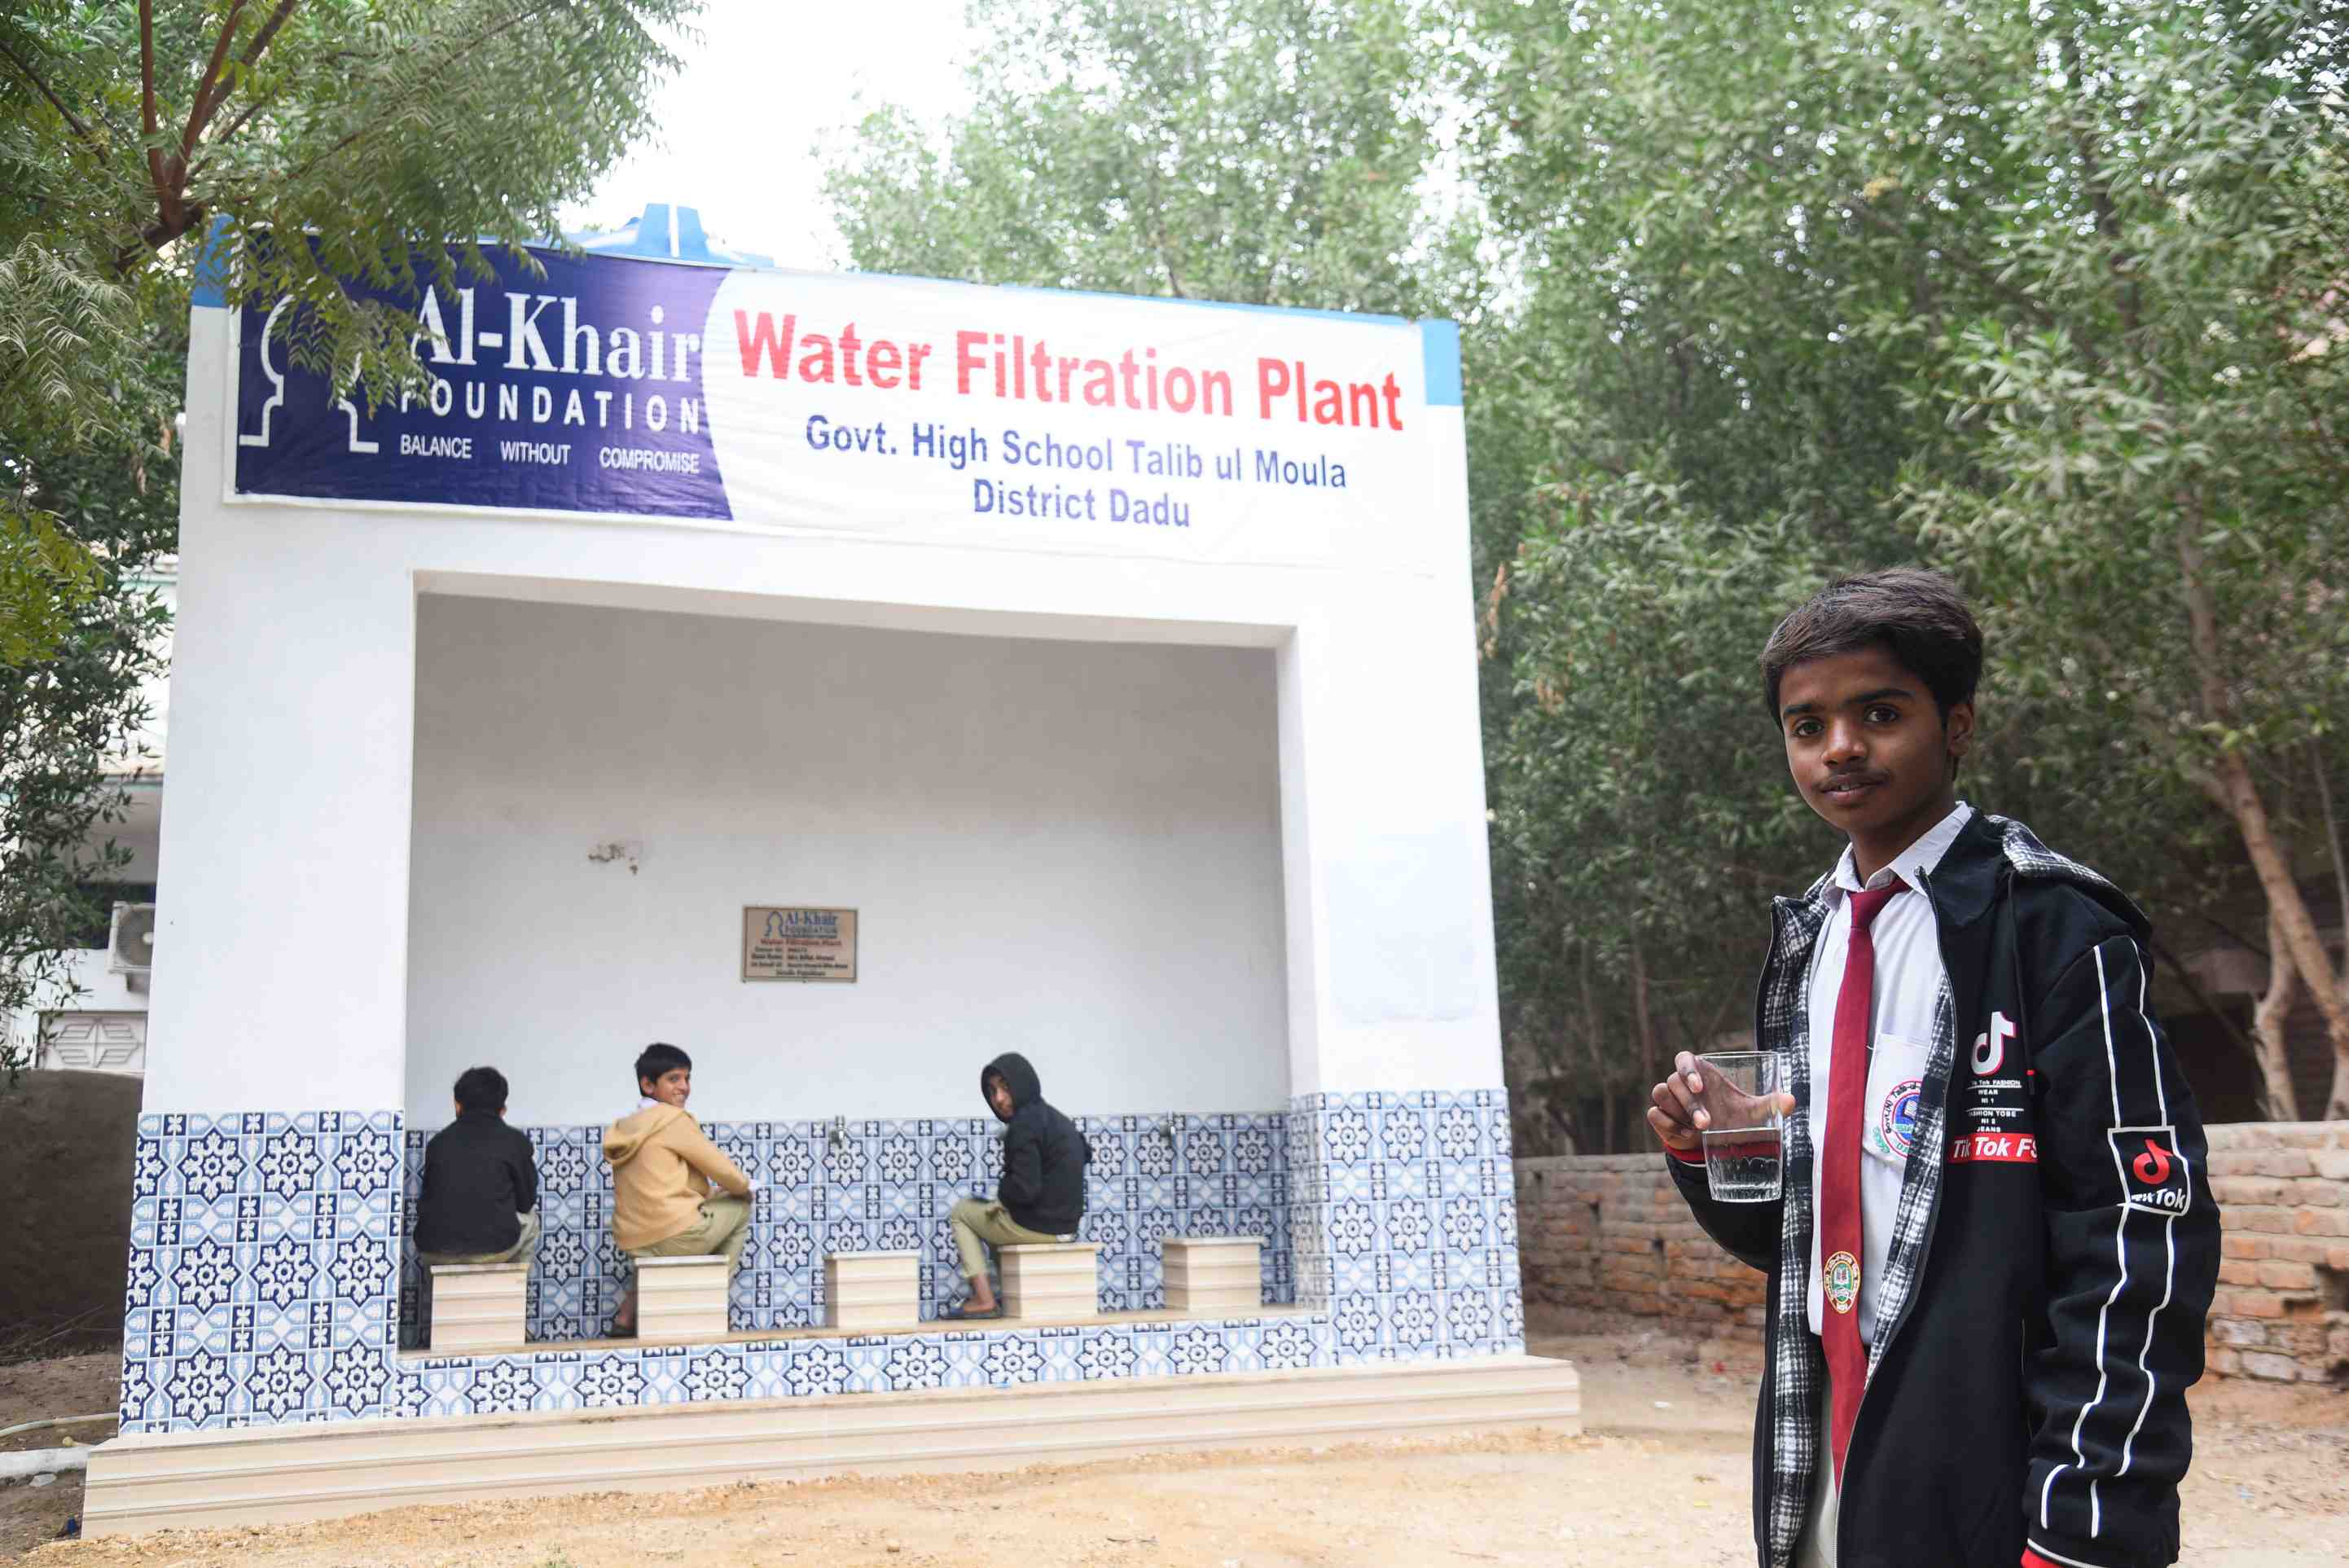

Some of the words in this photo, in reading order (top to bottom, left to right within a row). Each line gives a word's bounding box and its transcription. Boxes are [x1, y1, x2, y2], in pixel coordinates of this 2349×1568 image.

[410, 283, 702, 383] Al-Khair
[734, 309, 933, 391] Water
[956, 330, 1233, 416] Filtration
[1258, 357, 1403, 431] Plant
[401, 376, 700, 434] FOUNDATION
[399, 433, 472, 459] BALANCE
[500, 441, 571, 465] WITHOUT
[599, 446, 700, 474] COMPROMISE
[806, 415, 897, 455] Govt.
[912, 422, 988, 471] High
[1003, 429, 1113, 471] School
[1126, 438, 1203, 478] Talib
[1216, 447, 1241, 481] ul
[1255, 450, 1346, 488] Moula
[973, 478, 1096, 520] District
[1109, 488, 1190, 527] Dadu
[1953, 1140, 1971, 1158] Tik
[1975, 1136, 2012, 1156] Tok
